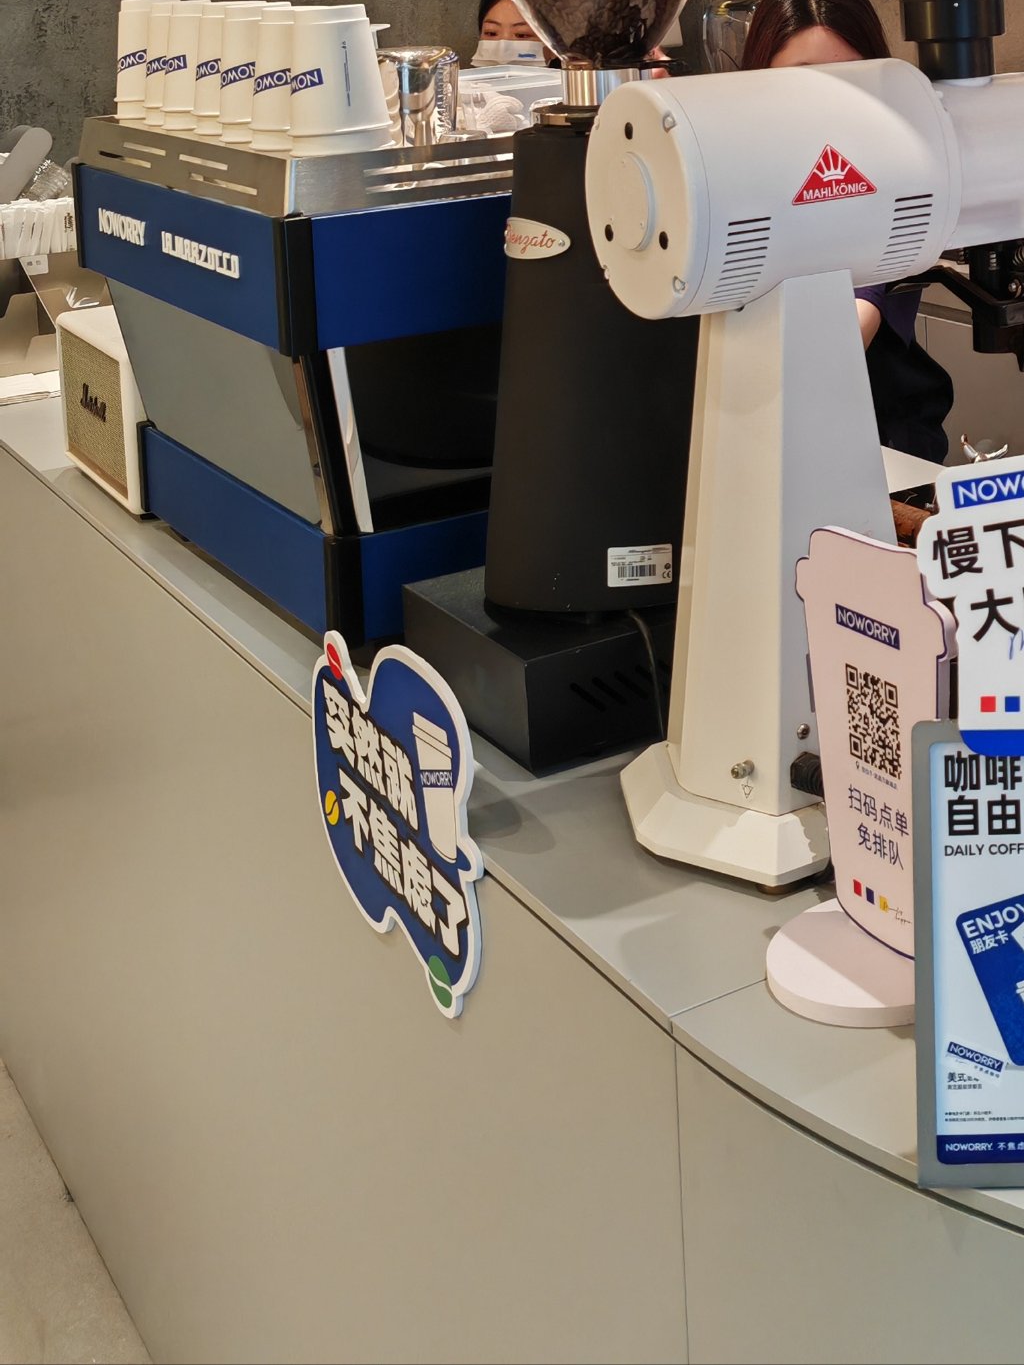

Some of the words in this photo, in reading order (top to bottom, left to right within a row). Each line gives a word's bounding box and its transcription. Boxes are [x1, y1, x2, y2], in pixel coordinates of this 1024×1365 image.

[803, 180, 868, 201] MAHLKÖNIG
[98, 207, 146, 246] NOWORRY
[837, 607, 899, 649] NOWORRY
[420, 771, 453, 786] NOWORRY
[943, 750, 1023, 792] 咖啡
[848, 784, 910, 837] 扫码点单
[857, 822, 904, 871] 免排队
[944, 843, 985, 857] DAILY
[969, 929, 1009, 955] 朋友卡
